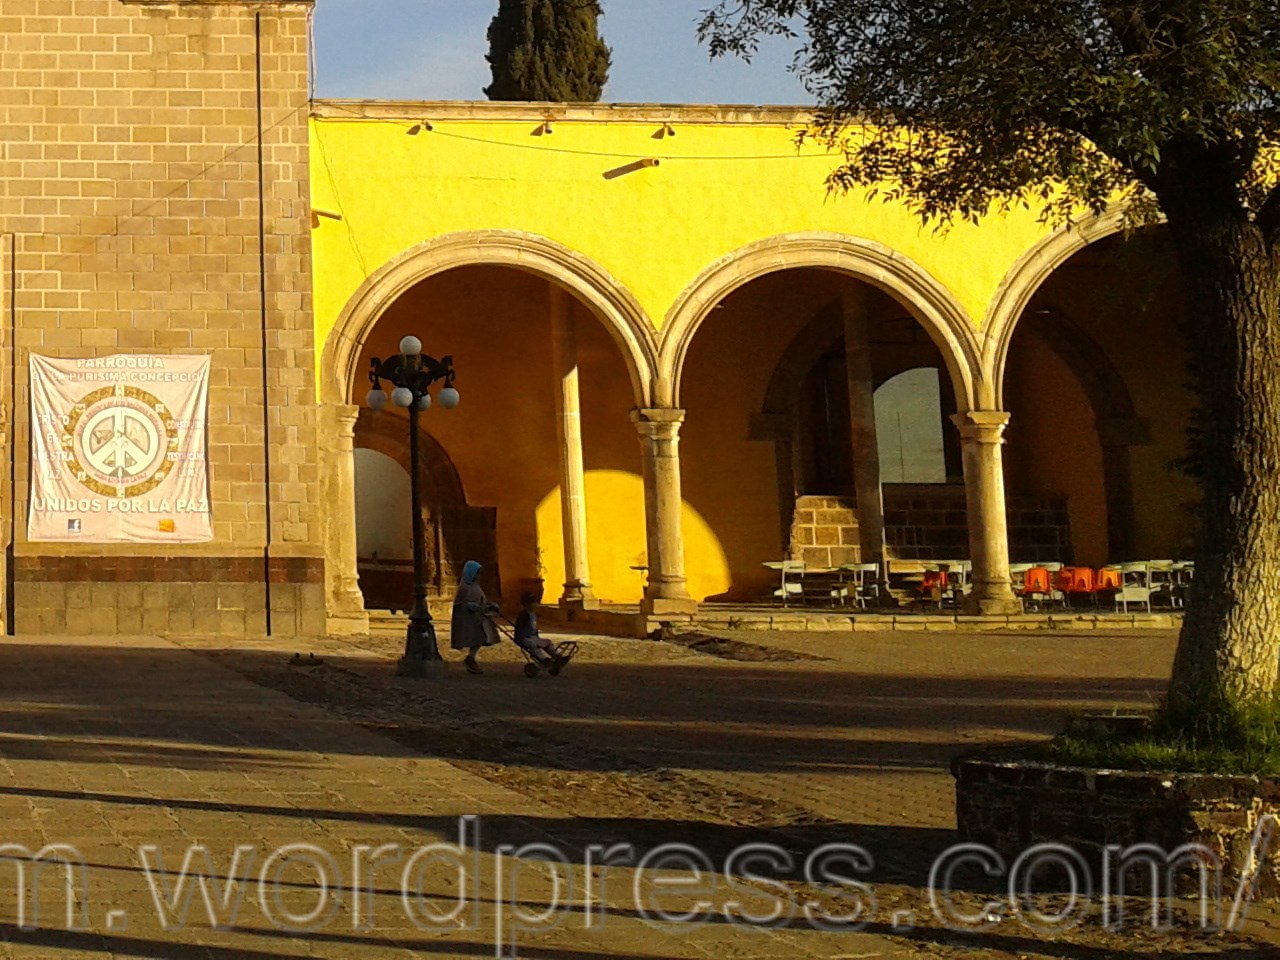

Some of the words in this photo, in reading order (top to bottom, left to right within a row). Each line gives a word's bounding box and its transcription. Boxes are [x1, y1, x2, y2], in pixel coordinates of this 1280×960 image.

[76, 357, 165, 368] PARROQUIA
[33, 498, 102, 512] UNIDOS
[106, 499, 145, 513] POR
[148, 499, 172, 513] LA
[176, 498, 210, 513] PAZ
